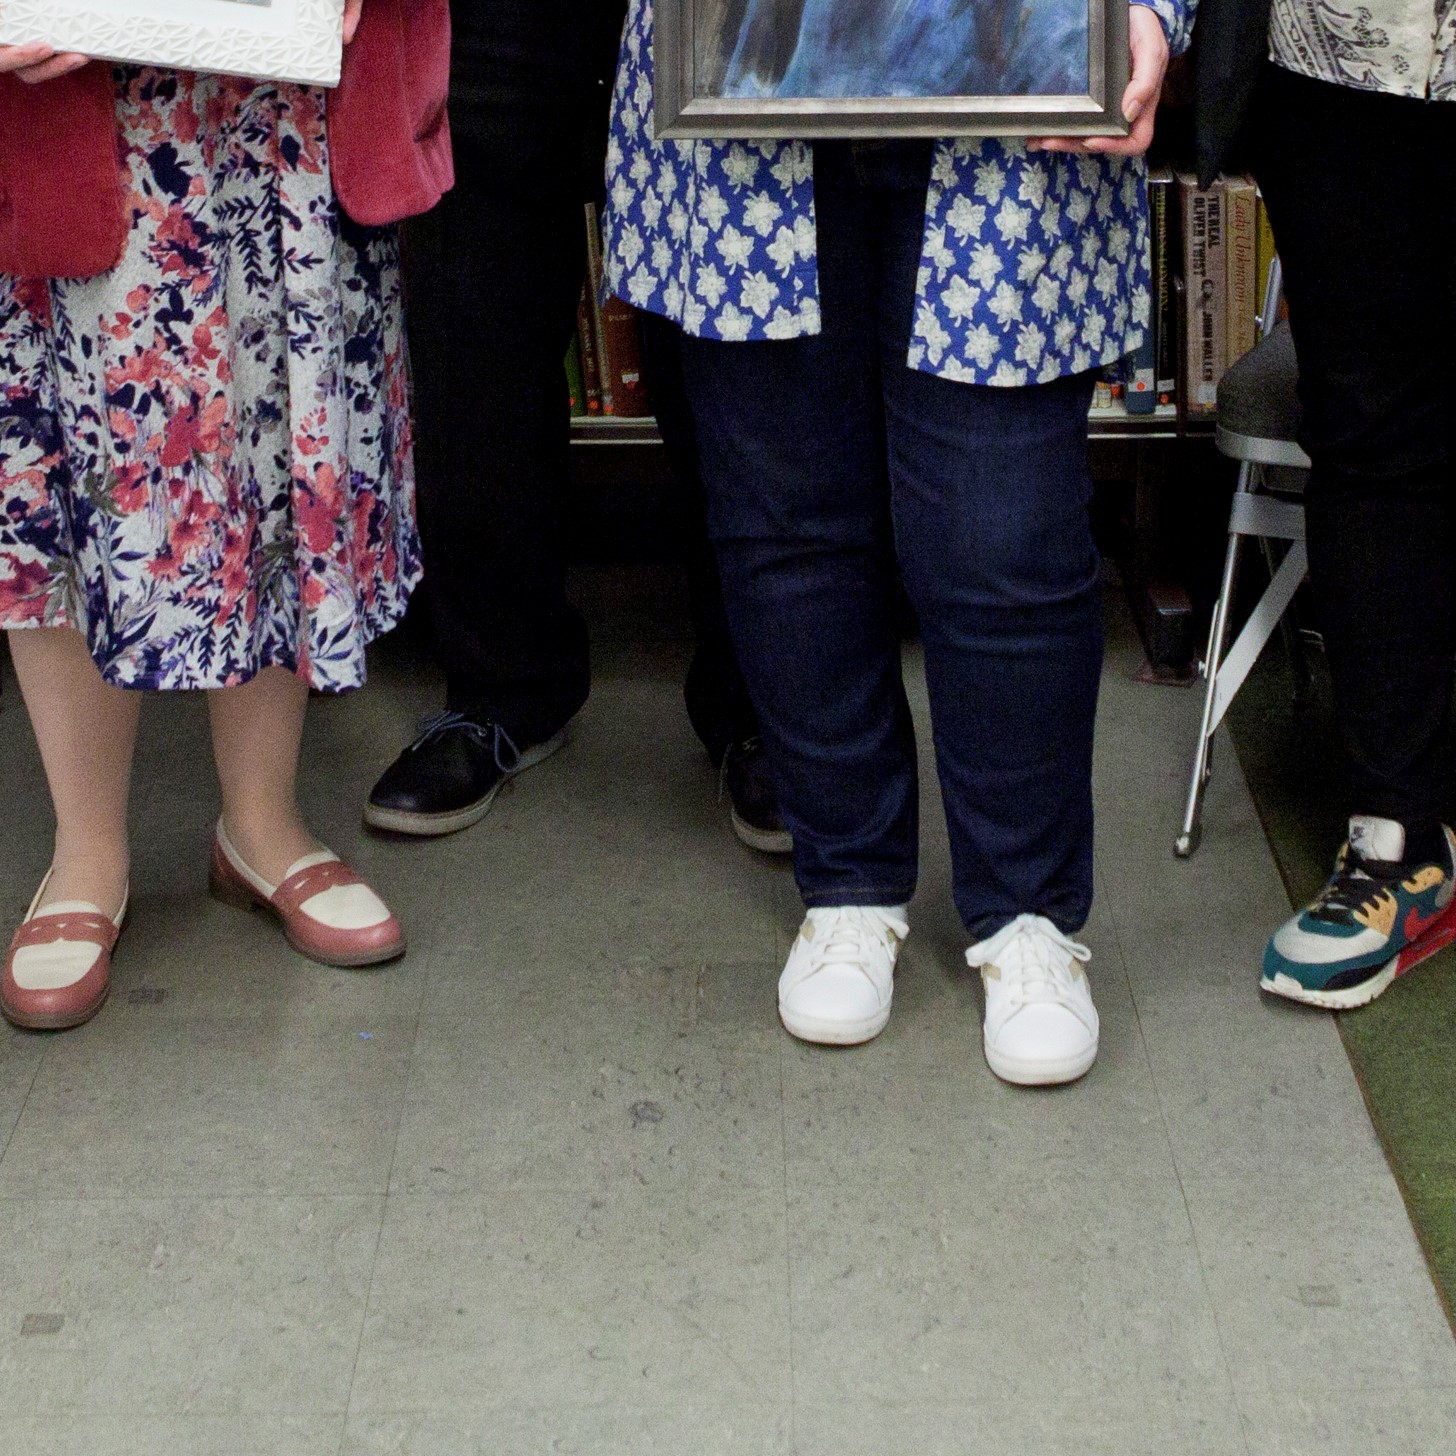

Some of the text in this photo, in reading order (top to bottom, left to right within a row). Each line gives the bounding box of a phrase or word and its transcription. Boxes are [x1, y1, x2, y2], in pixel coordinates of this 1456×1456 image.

[1194, 197, 1206, 277] OLIVER TWIST
[1208, 196, 1220, 250] THE REAL
[1231, 195, 1252, 303] Lady Unknown
[1203, 311, 1213, 382] JOHN WALLER
